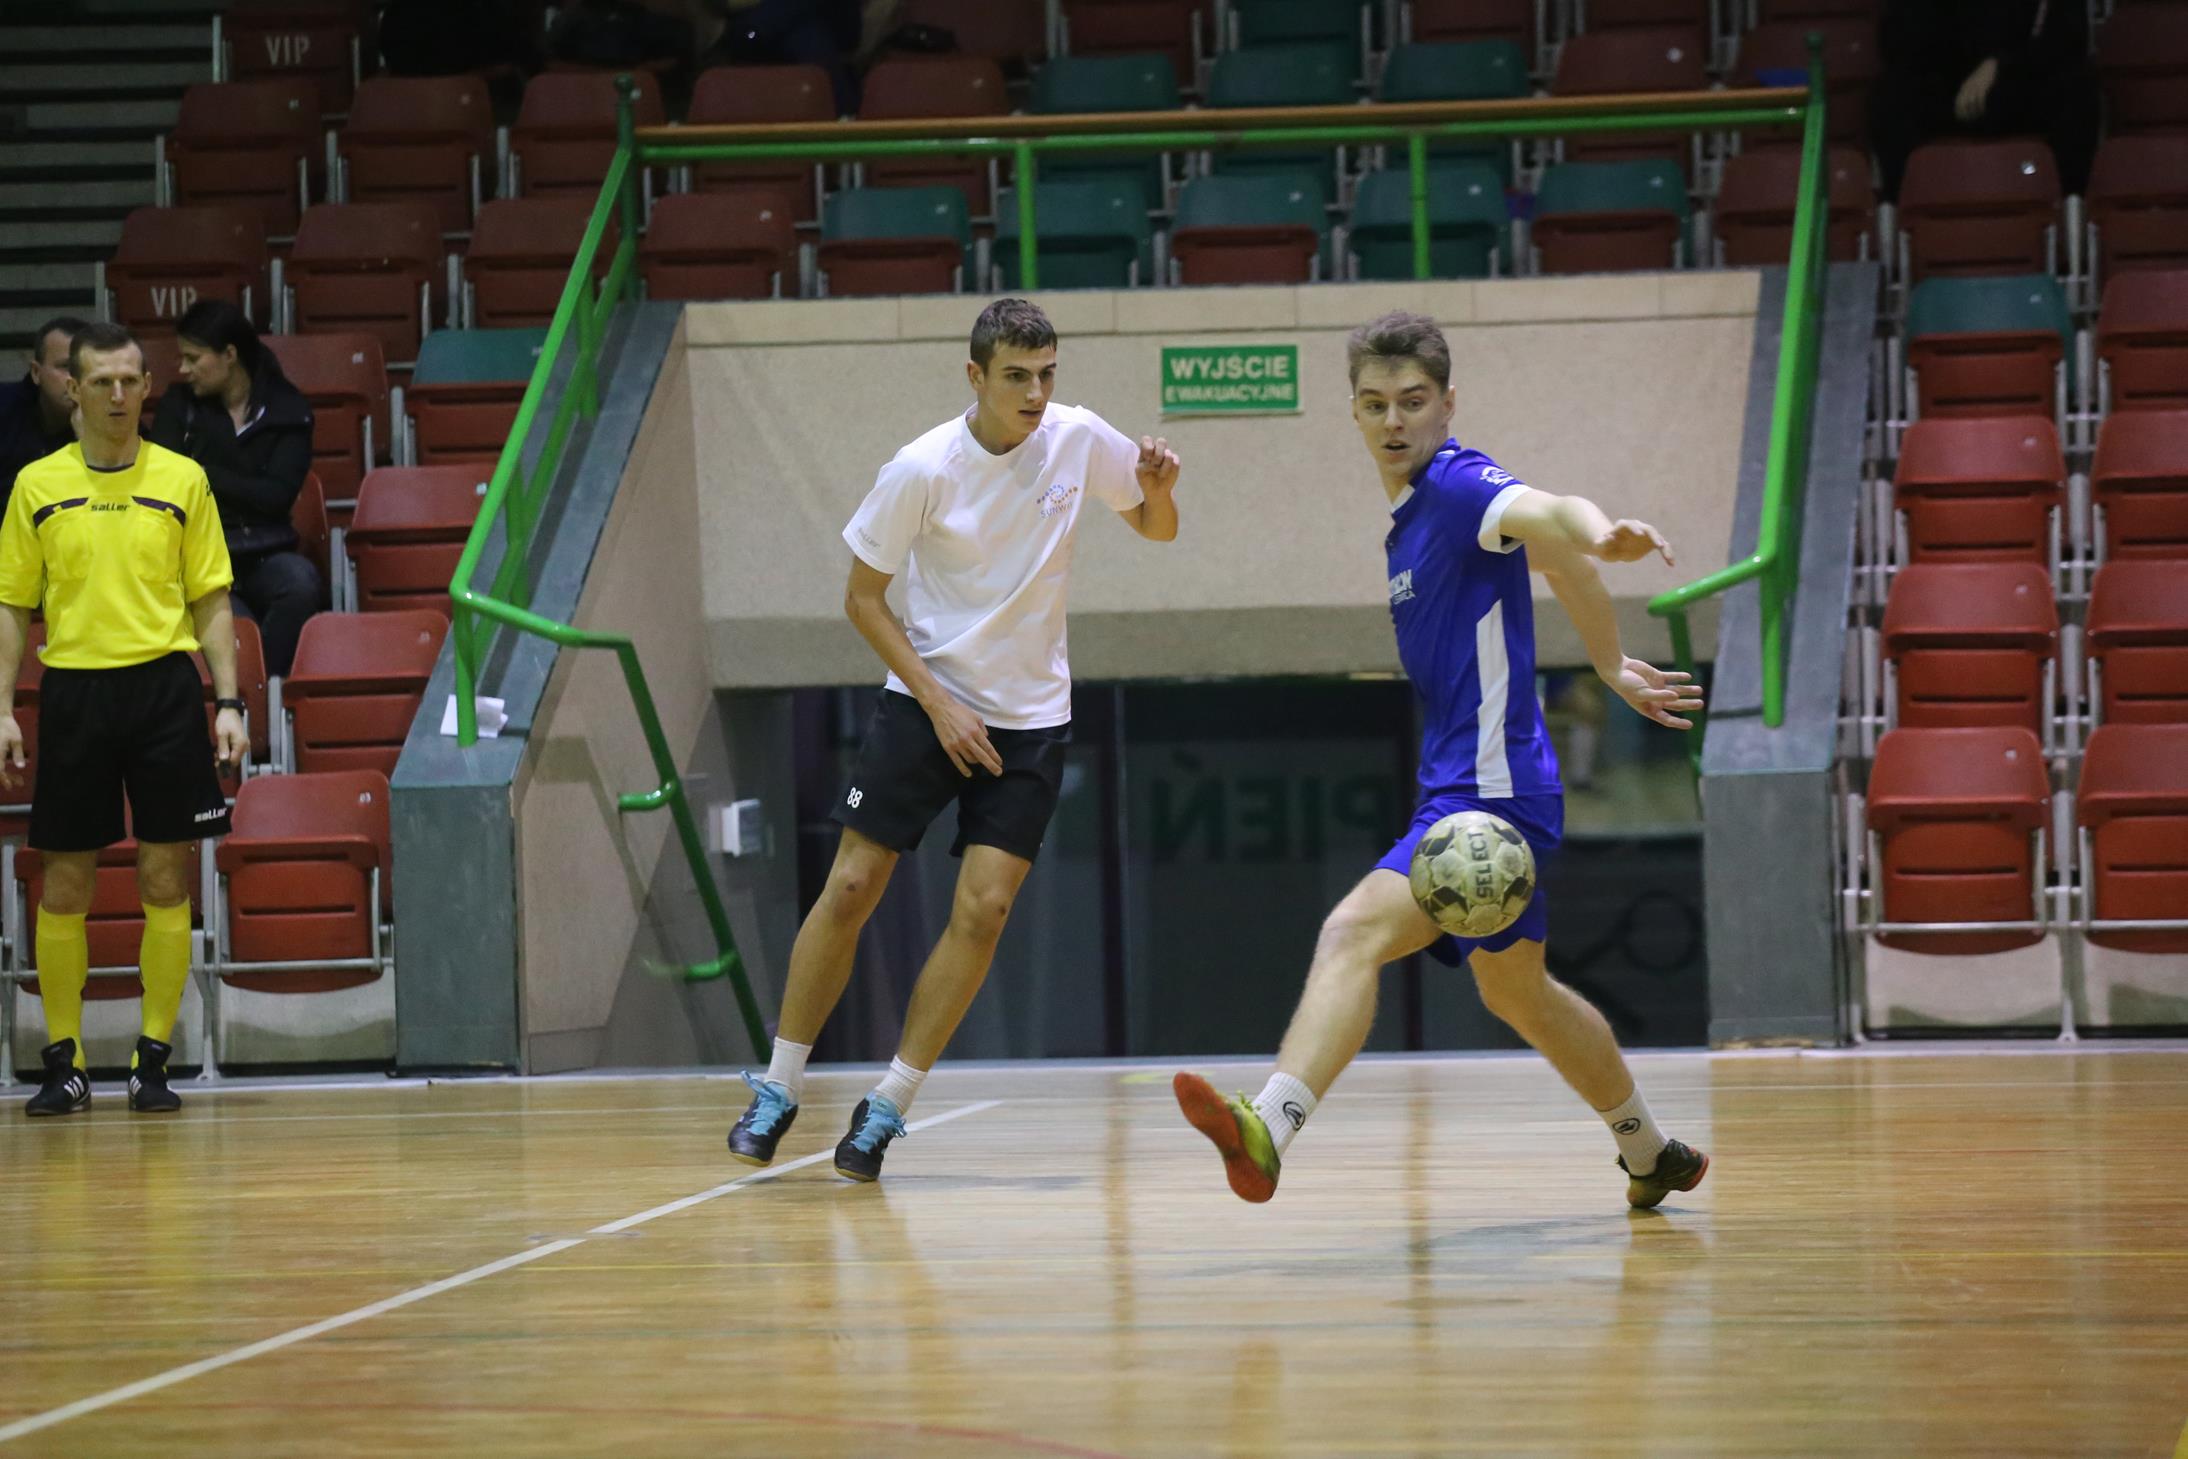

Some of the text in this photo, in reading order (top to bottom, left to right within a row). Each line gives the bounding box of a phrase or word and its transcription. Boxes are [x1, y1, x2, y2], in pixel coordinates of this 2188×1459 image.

[265, 35, 310, 65] VIP
[150, 286, 197, 317] VIP
[1170, 353, 1290, 379] WYJŚCIE
[1164, 383, 1295, 402] EWAKUACYJNE
[91, 503, 128, 512] saller
[847, 787, 863, 809] 88
[194, 807, 227, 823] saller
[1467, 831, 1495, 899] SELECT
